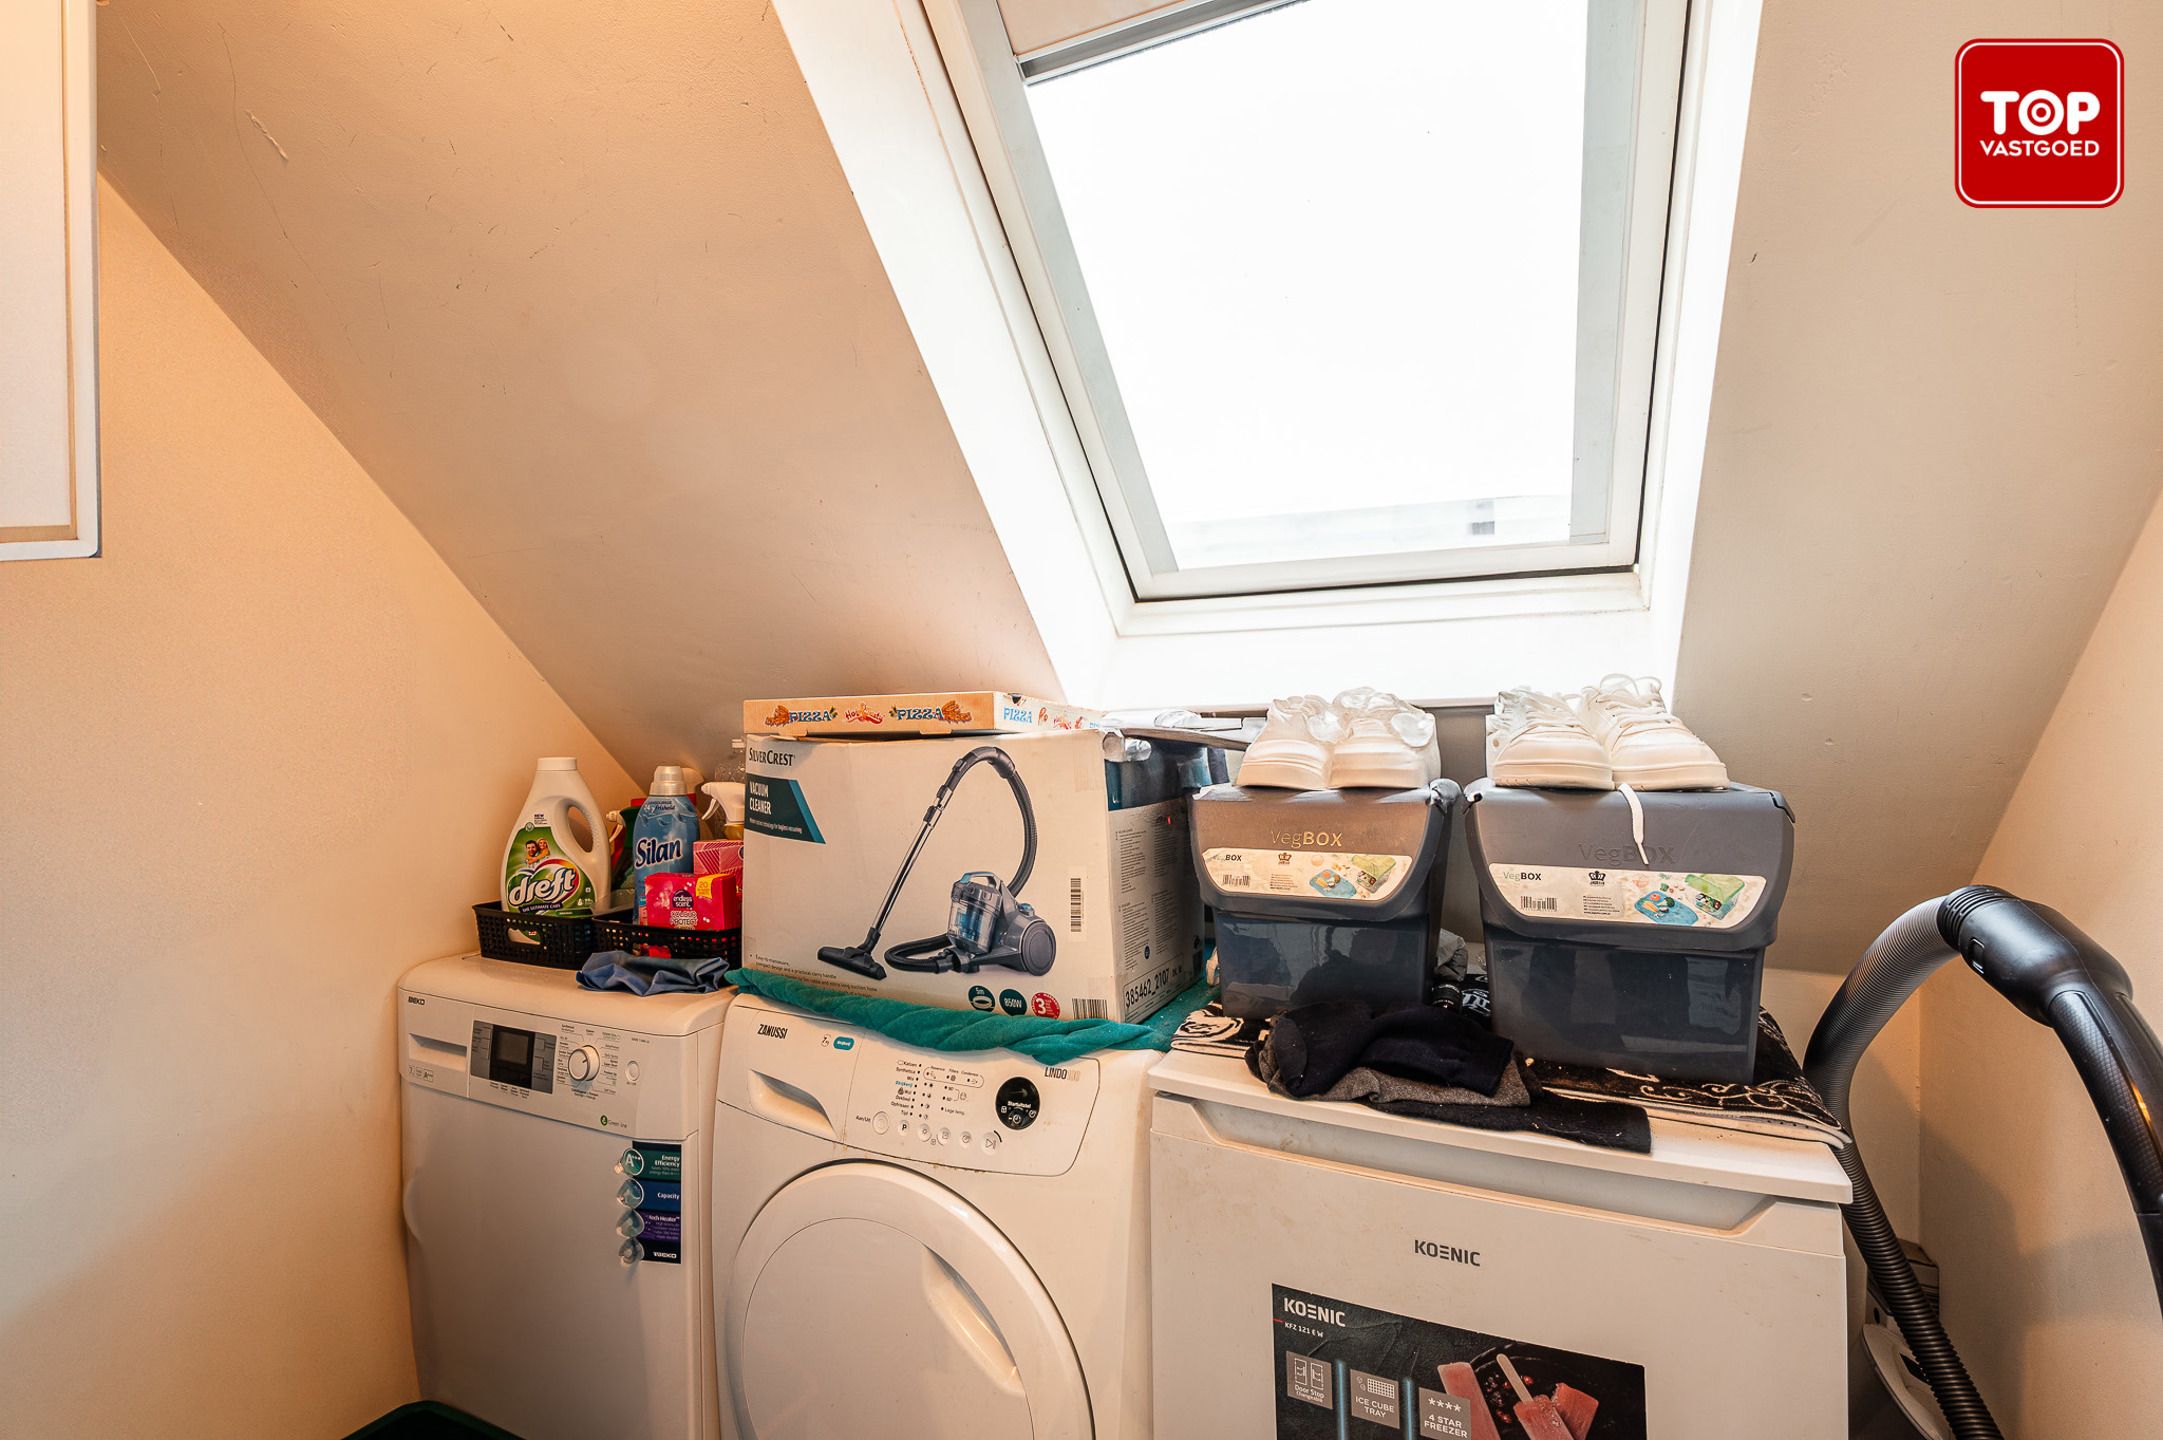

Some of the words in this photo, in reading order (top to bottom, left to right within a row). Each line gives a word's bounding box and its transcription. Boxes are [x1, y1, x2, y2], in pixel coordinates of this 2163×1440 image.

[789, 709, 832, 723] PIZZA
[897, 707, 945, 720] PIZZA
[1003, 707, 1032, 723] PIZZA
[749, 781, 769, 798] VACUUM
[749, 798, 772, 815] CLEANER
[1271, 831, 1342, 848] VegBOX
[635, 838, 682, 868] Silan
[1503, 871, 1542, 882] VegBOX
[508, 868, 577, 906] dreft
[975, 987, 985, 995] 5m
[1125, 967, 1170, 1008] 385462_2107
[1003, 997, 1022, 1009] 850W
[1035, 997, 1046, 1014] 3
[757, 1023, 788, 1039] ZANUSSI
[661, 1154, 681, 1162] Energy
[657, 1192, 680, 1200] Capacity
[1414, 1239, 1481, 1267] KOENIC
[1283, 1297, 1346, 1328] KOENIC
[1284, 1321, 1297, 1332] KFZ
[1298, 1324, 1310, 1334] 121
[1294, 1384, 1309, 1394] Door
[1310, 1388, 1325, 1399] Stop
[1355, 1396, 1369, 1406] ICE
[1371, 1400, 1395, 1413] CUBE
[1364, 1406, 1386, 1418] TRAY
[1429, 1414, 1435, 1422] 4
[1437, 1416, 1462, 1428] STAR
[1424, 1420, 1468, 1439] FREEZER
